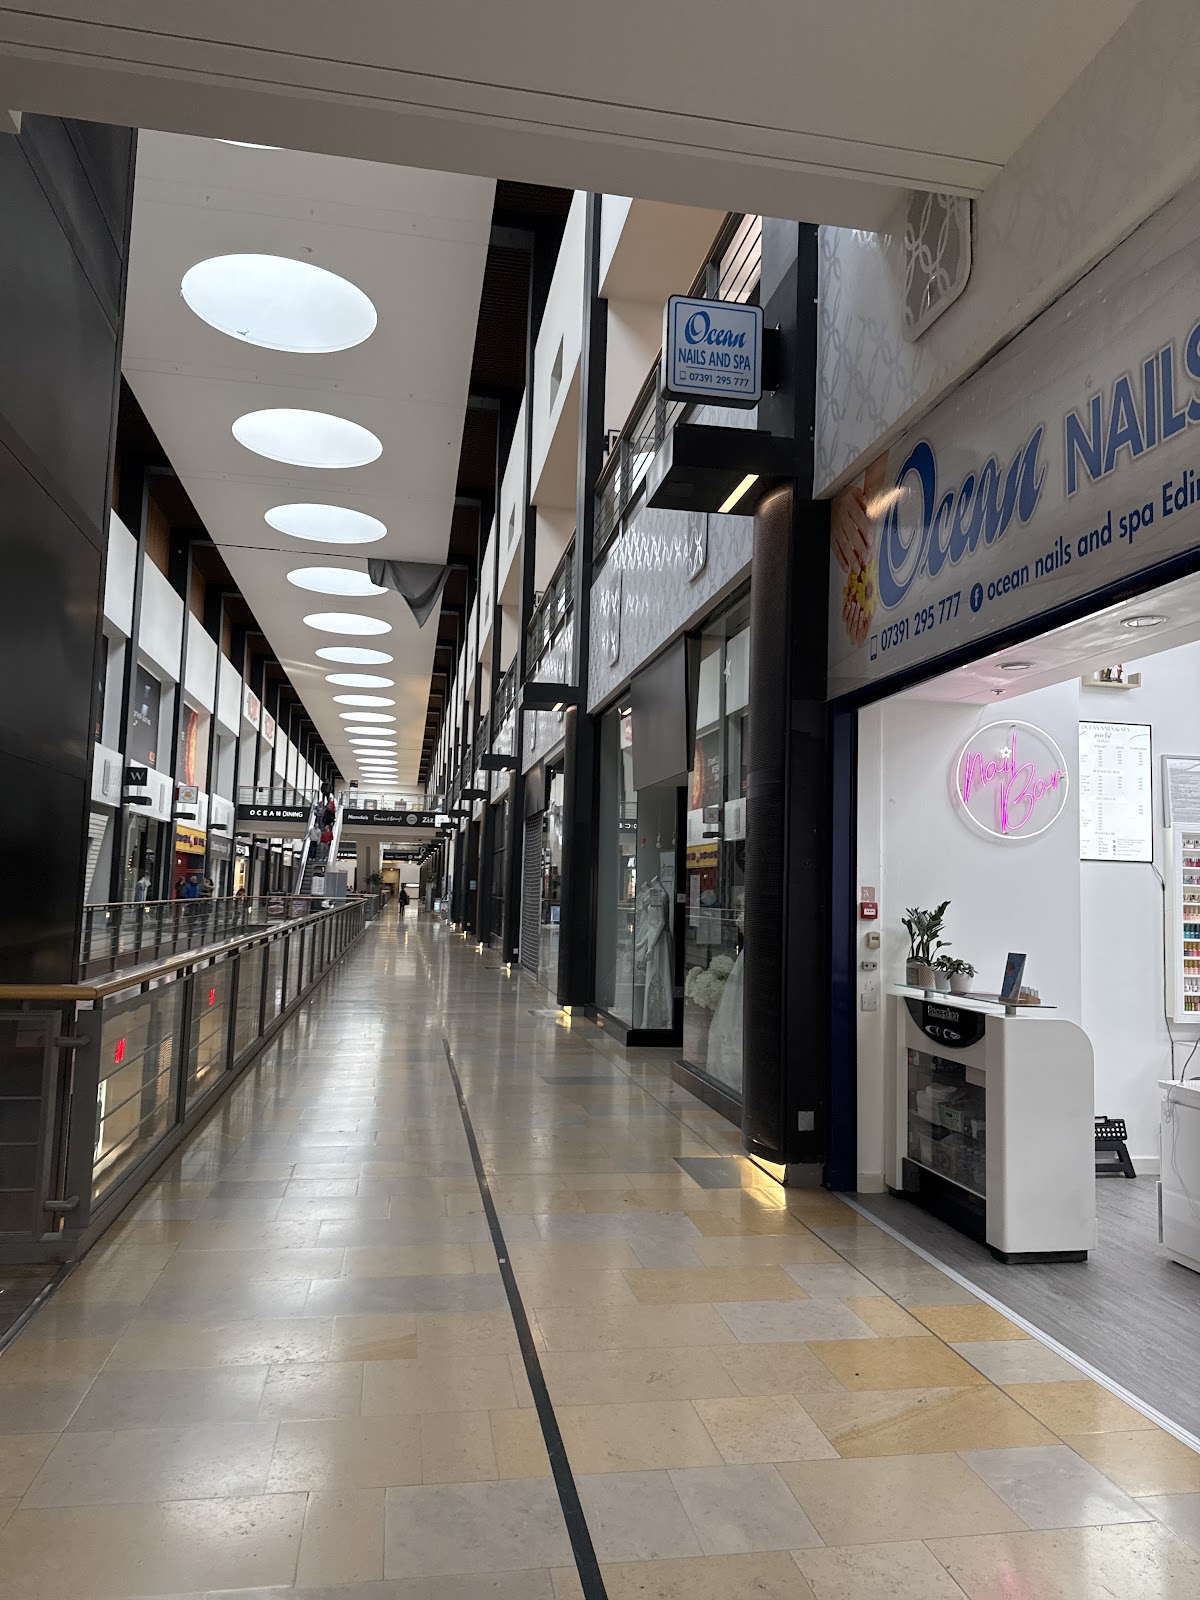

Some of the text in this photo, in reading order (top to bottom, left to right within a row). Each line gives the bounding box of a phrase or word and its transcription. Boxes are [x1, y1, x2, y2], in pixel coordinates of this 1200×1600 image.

[685, 311, 746, 348] Ocean
[679, 348, 751, 371] NAILS AND SPA
[689, 372, 749, 387] 07391 295 777
[878, 425, 1046, 609] Ocean
[881, 618, 909, 651] 07391
[914, 605, 935, 636] 295
[939, 591, 961, 625] 777
[987, 564, 1029, 601] ocean
[1035, 535, 1072, 579] nails
[1077, 510, 1112, 558] and
[1119, 501, 1153, 545] spa
[130, 771, 144, 781] W
[964, 731, 1018, 804] Nail
[1001, 762, 1067, 834] Bar
[250, 809, 303, 818] OCEAN DINING
[927, 1005, 959, 1020] Reception
